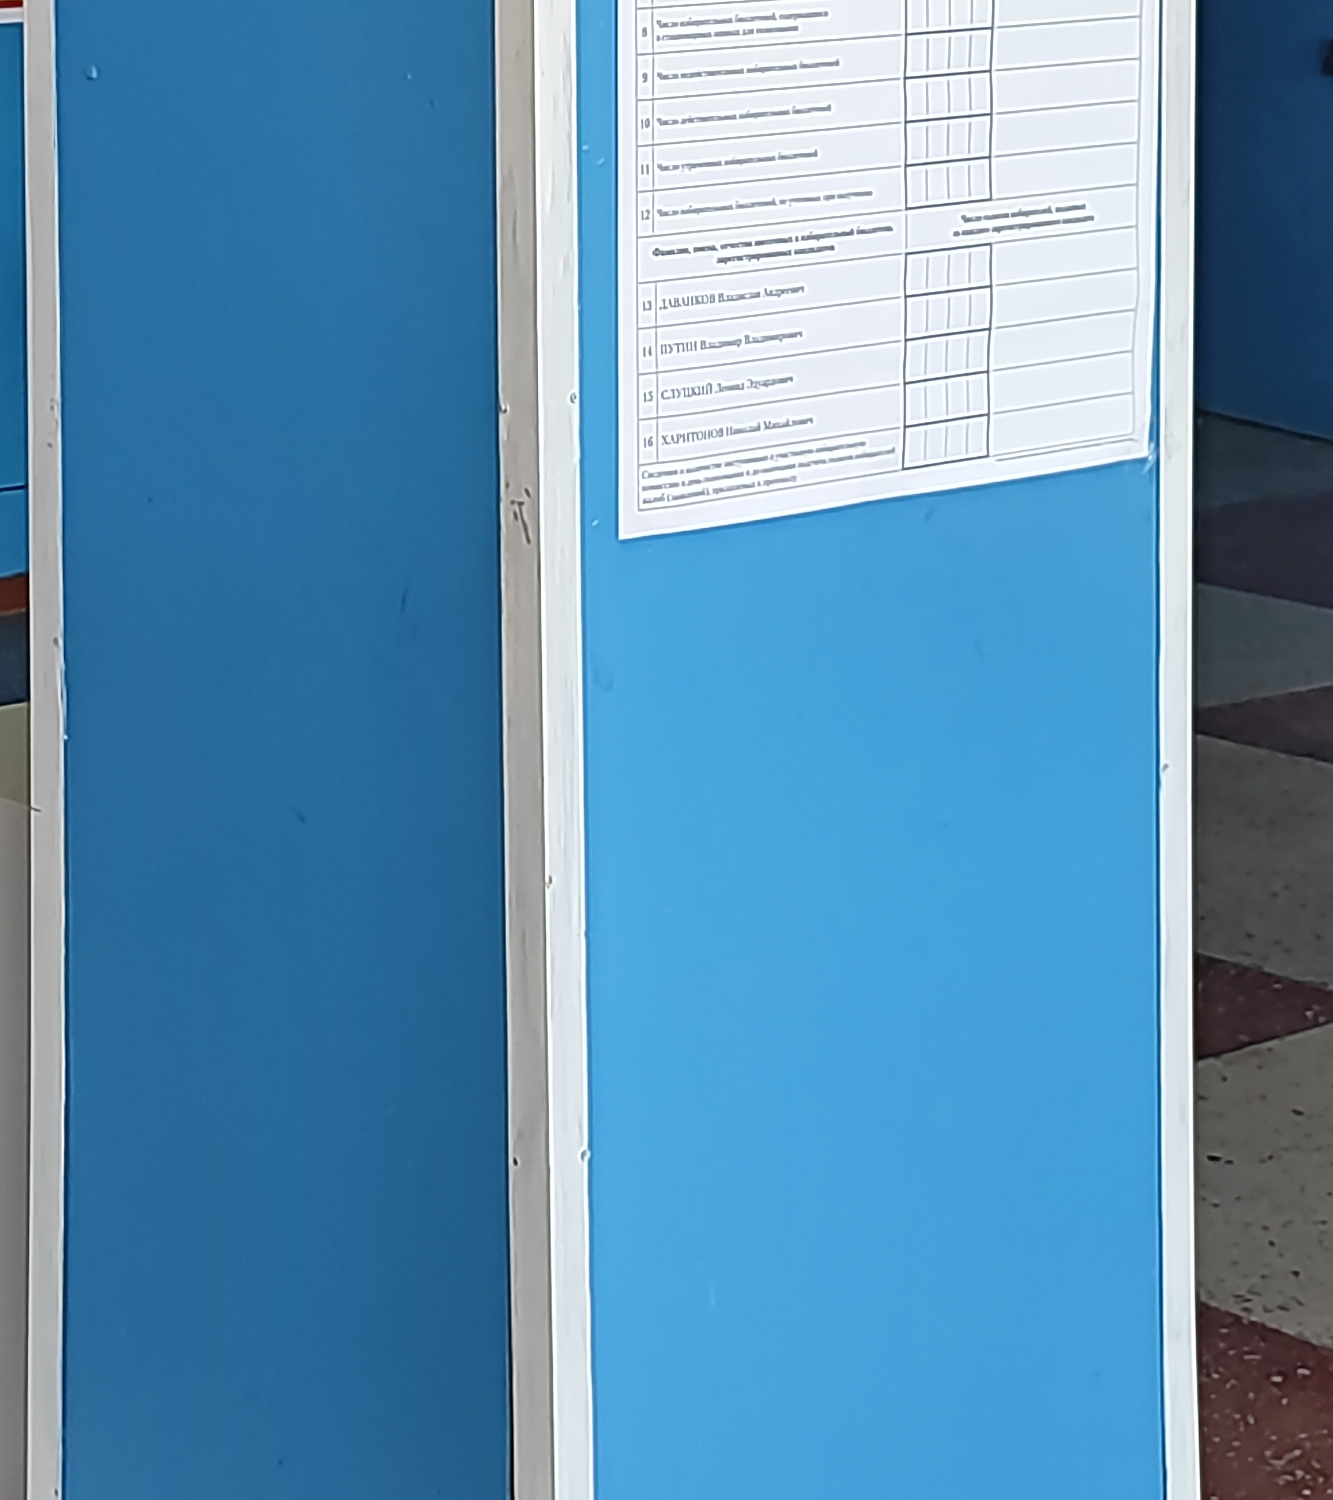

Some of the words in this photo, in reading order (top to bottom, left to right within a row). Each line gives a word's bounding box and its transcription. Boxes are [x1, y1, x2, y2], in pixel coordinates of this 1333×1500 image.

[640, 118, 651, 130] 10
[660, 340, 698, 356] ПУТИН
[643, 390, 654, 403] 15
[660, 382, 713, 401] СЛУЦКИЙ
[643, 436, 654, 449] 16
[661, 427, 724, 446] ХАРИТОНОВ
